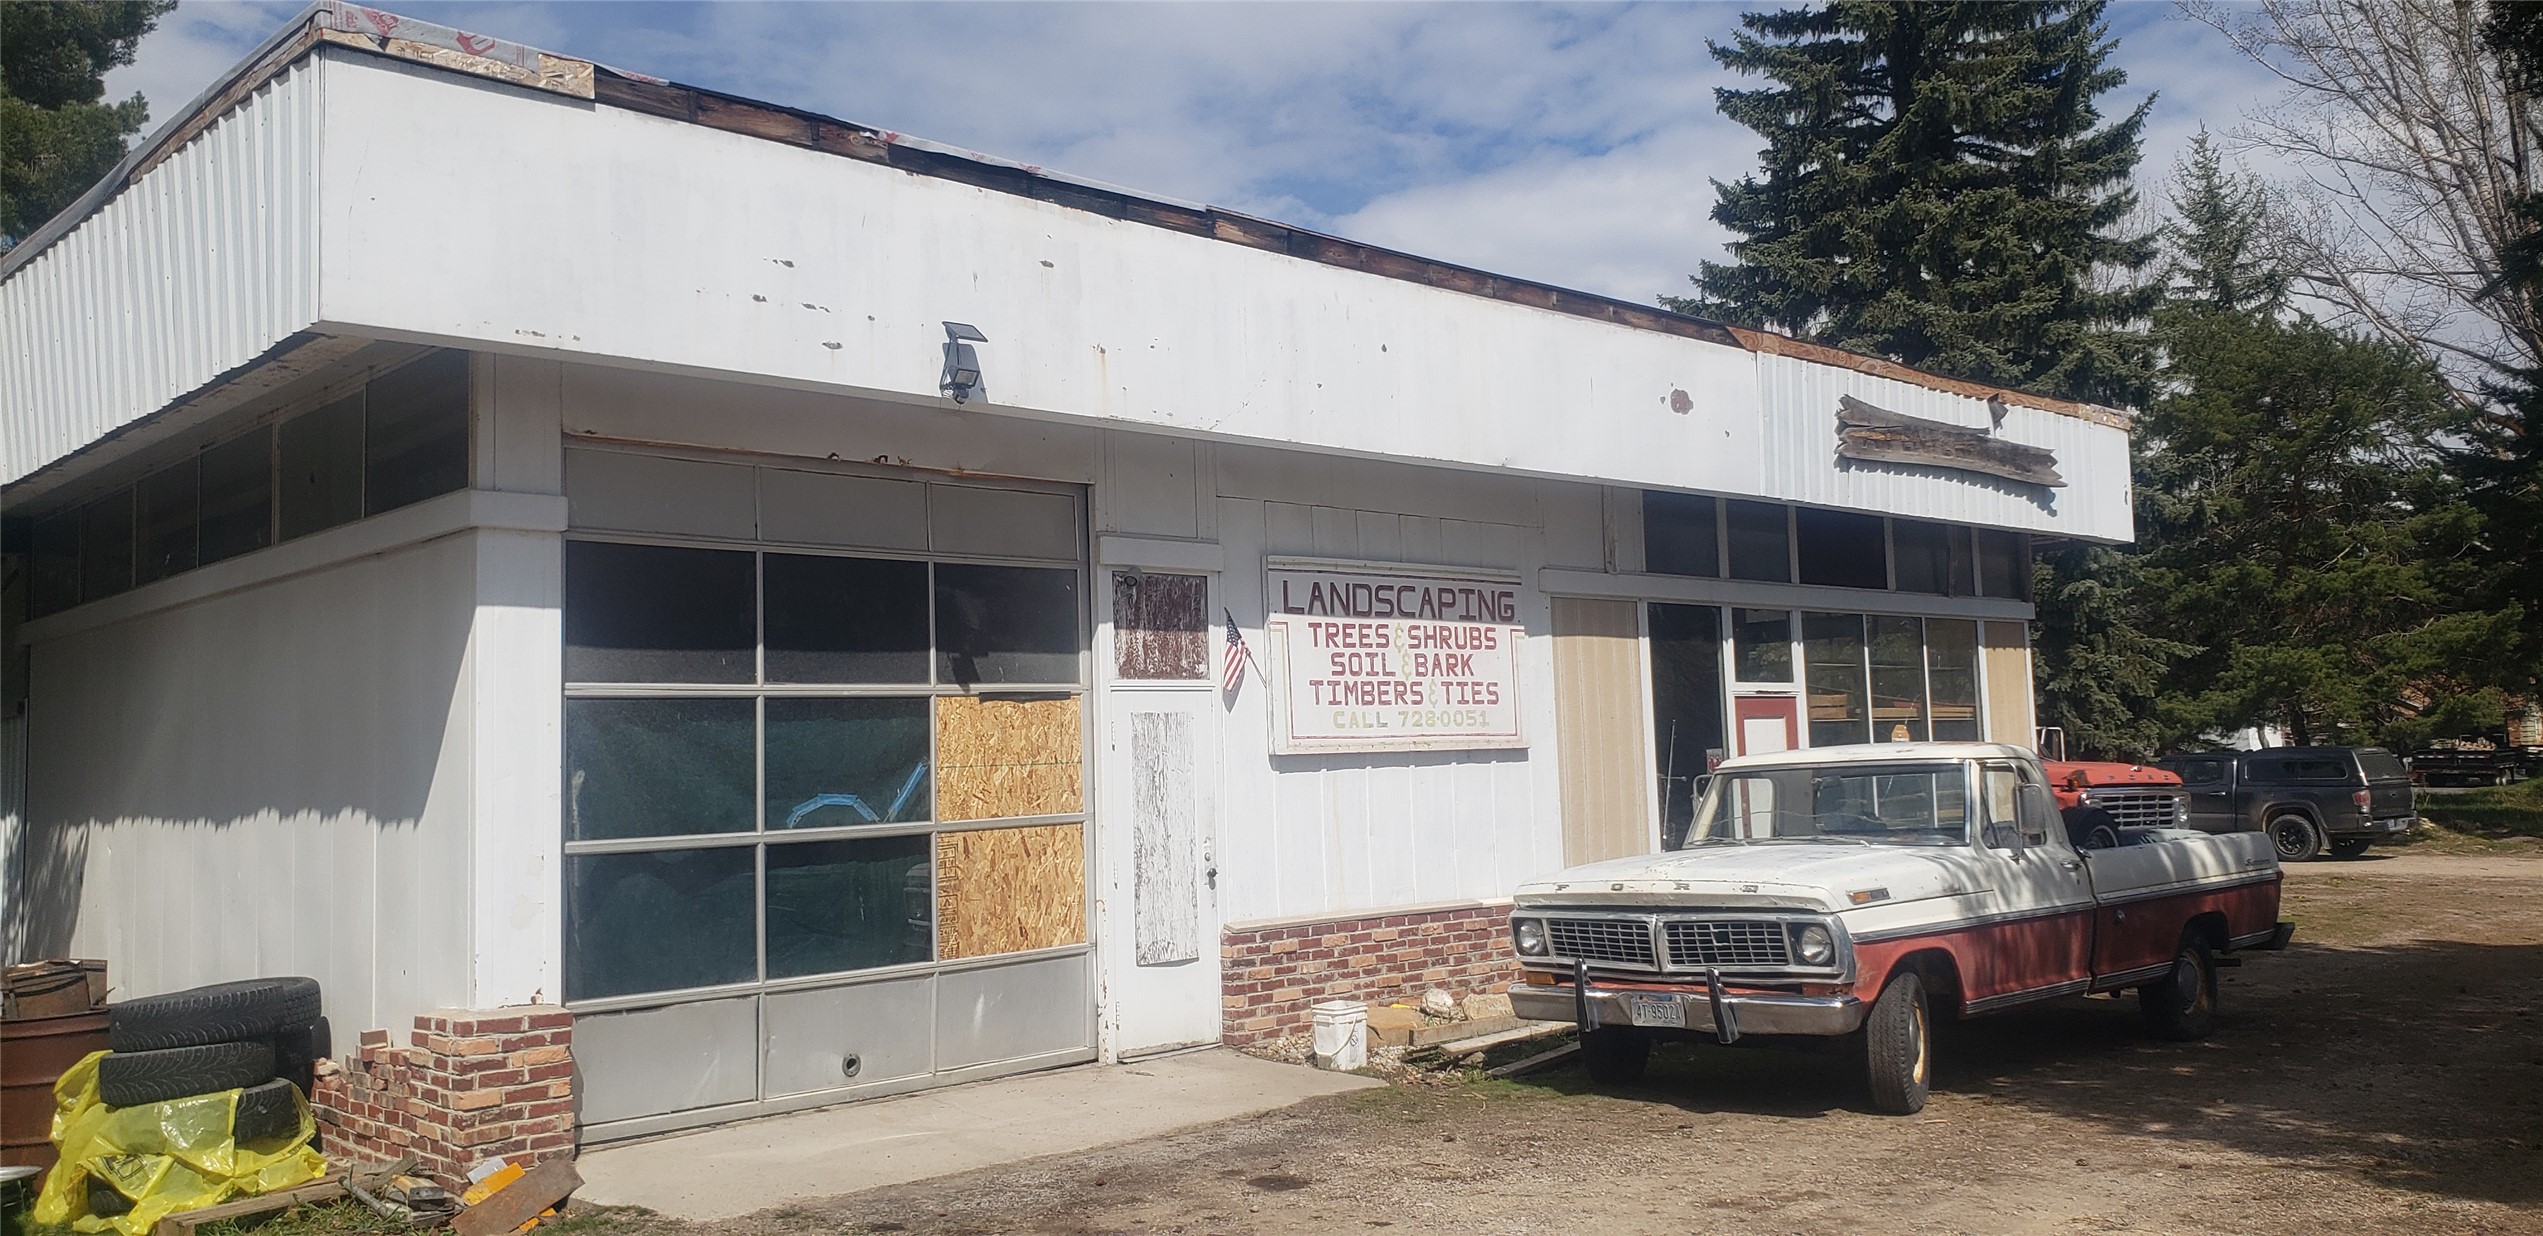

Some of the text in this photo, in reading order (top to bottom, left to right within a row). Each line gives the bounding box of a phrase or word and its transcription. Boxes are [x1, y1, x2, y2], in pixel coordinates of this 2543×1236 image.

[1282, 580, 1515, 621] LANDSCAPING
[1308, 622, 1497, 653] TREES & SHRUBS
[1331, 649, 1475, 680] SOIL & BARK
[1309, 679, 1499, 708] TIMBERS & TIES
[1332, 711, 1389, 729] CALL
[1555, 883, 1759, 893] FORD
